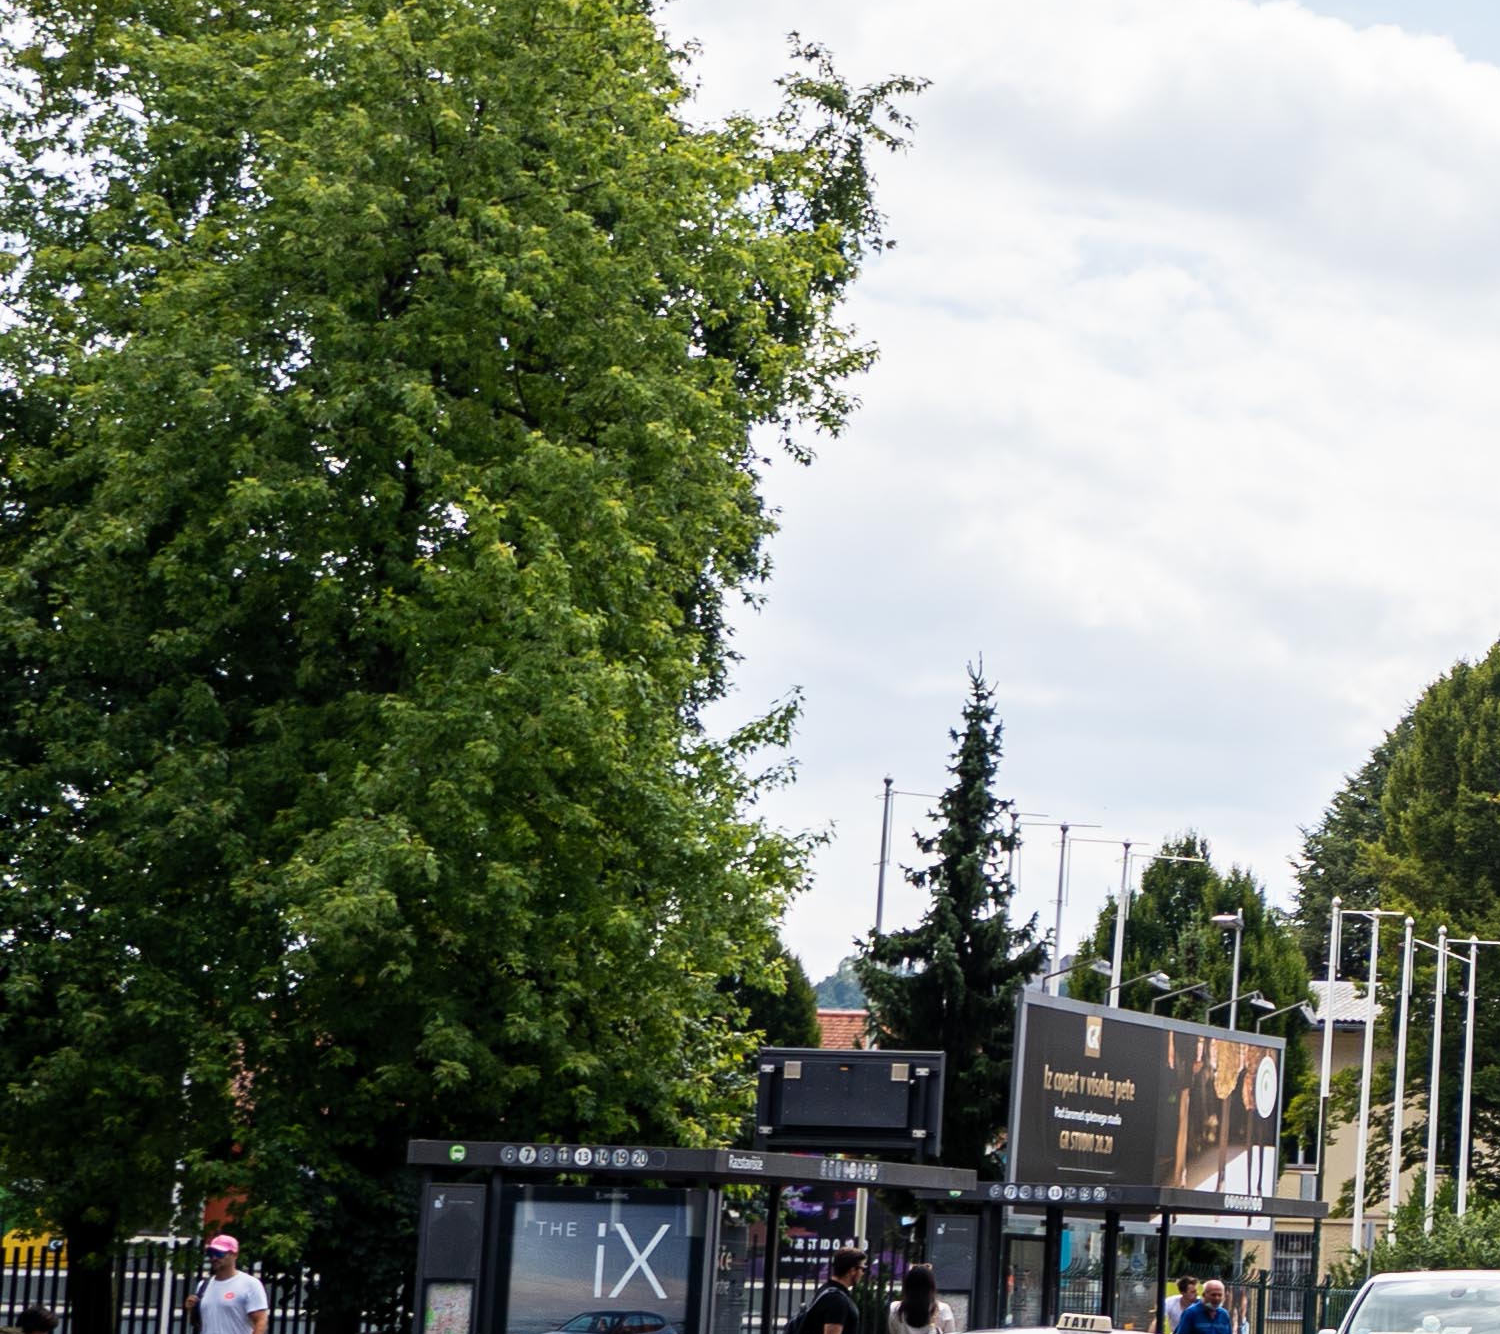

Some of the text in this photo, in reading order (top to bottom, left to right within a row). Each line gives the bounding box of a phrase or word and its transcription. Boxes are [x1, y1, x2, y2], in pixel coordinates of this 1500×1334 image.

[1044, 1064, 1052, 1090] Iz
[1054, 1071, 1078, 1098] copat
[1087, 1071, 1113, 1099] visoke
[1114, 1079, 1136, 1105] pete
[577, 1151, 590, 1162] 13
[615, 1152, 627, 1163] 19
[634, 1152, 647, 1163] 20
[536, 1221, 577, 1237] THE
[594, 1223, 671, 1299] iX
[1063, 1316, 1096, 1329] TAXI
